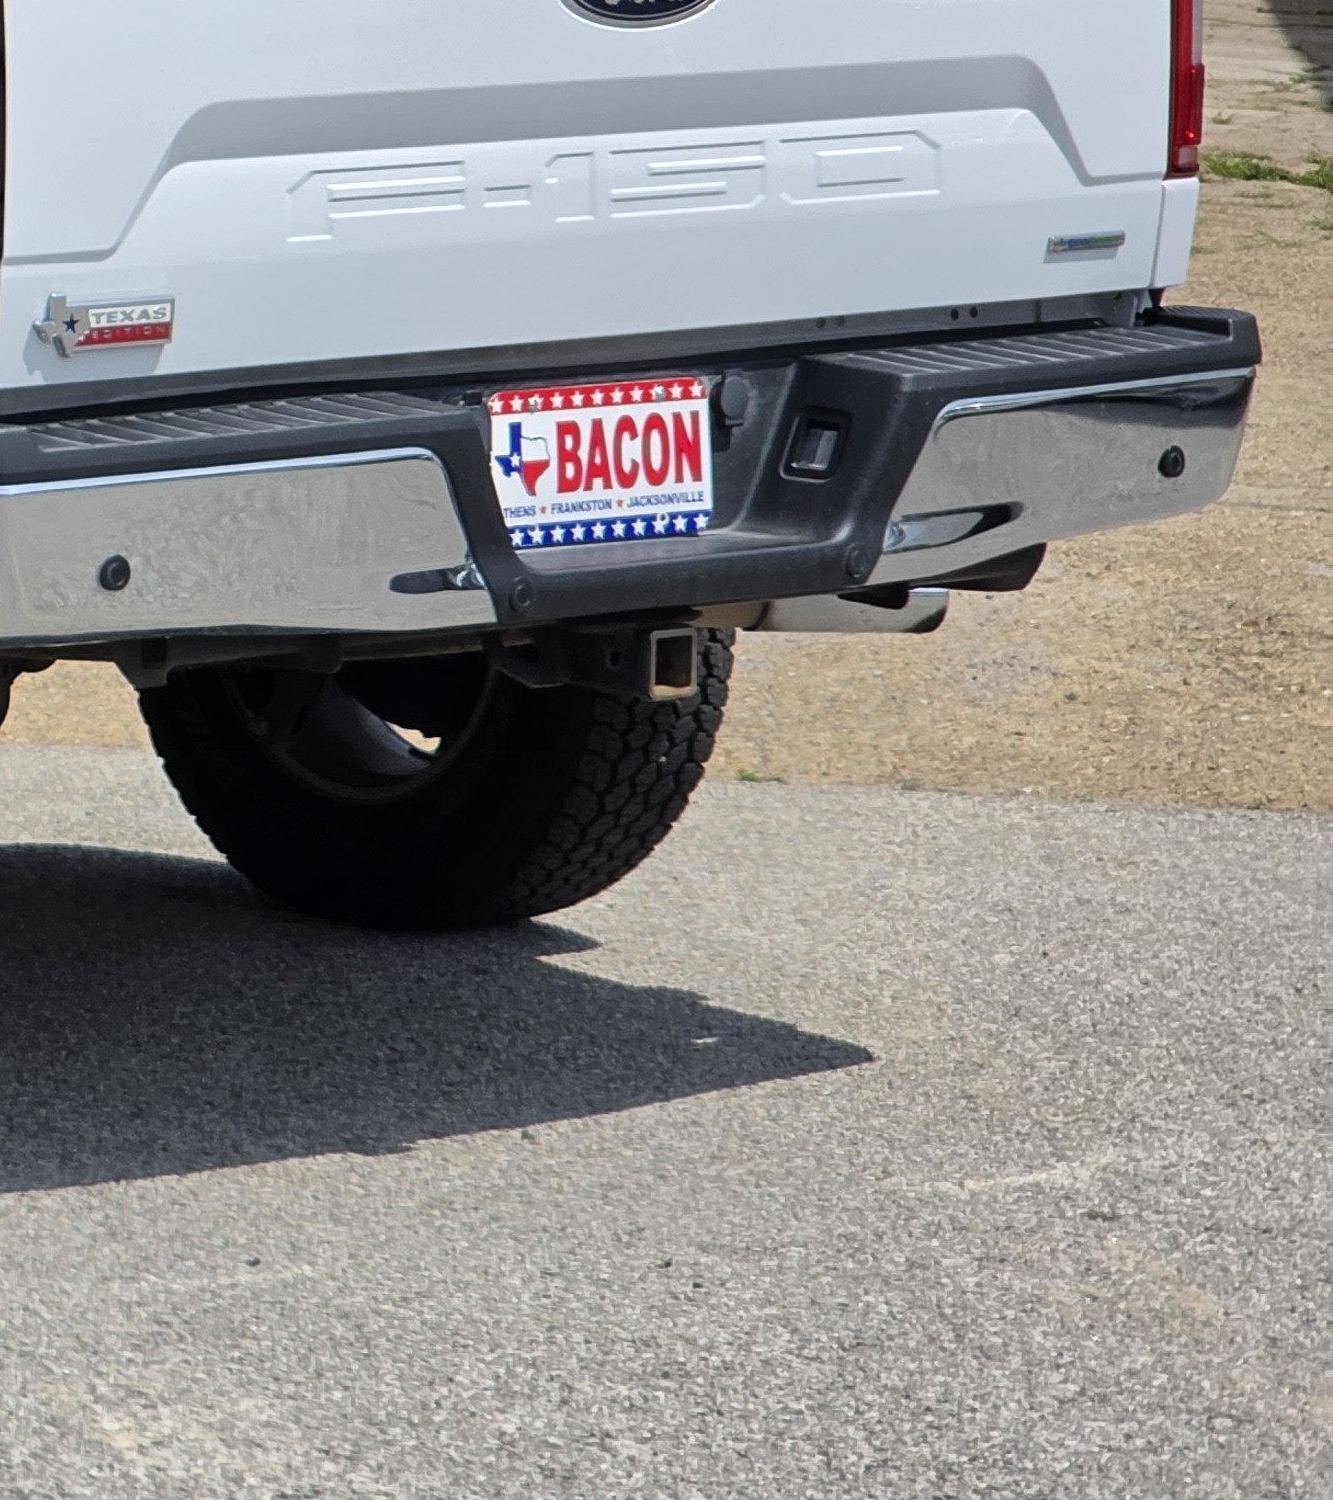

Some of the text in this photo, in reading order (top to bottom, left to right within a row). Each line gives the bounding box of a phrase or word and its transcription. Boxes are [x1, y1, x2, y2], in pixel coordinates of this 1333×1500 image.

[286, 130, 941, 243] F-150
[91, 306, 167, 325] TEXAS
[555, 410, 703, 494] BACON
[504, 490, 704, 518] THENS FRANKSTON JACKSONVILLE
